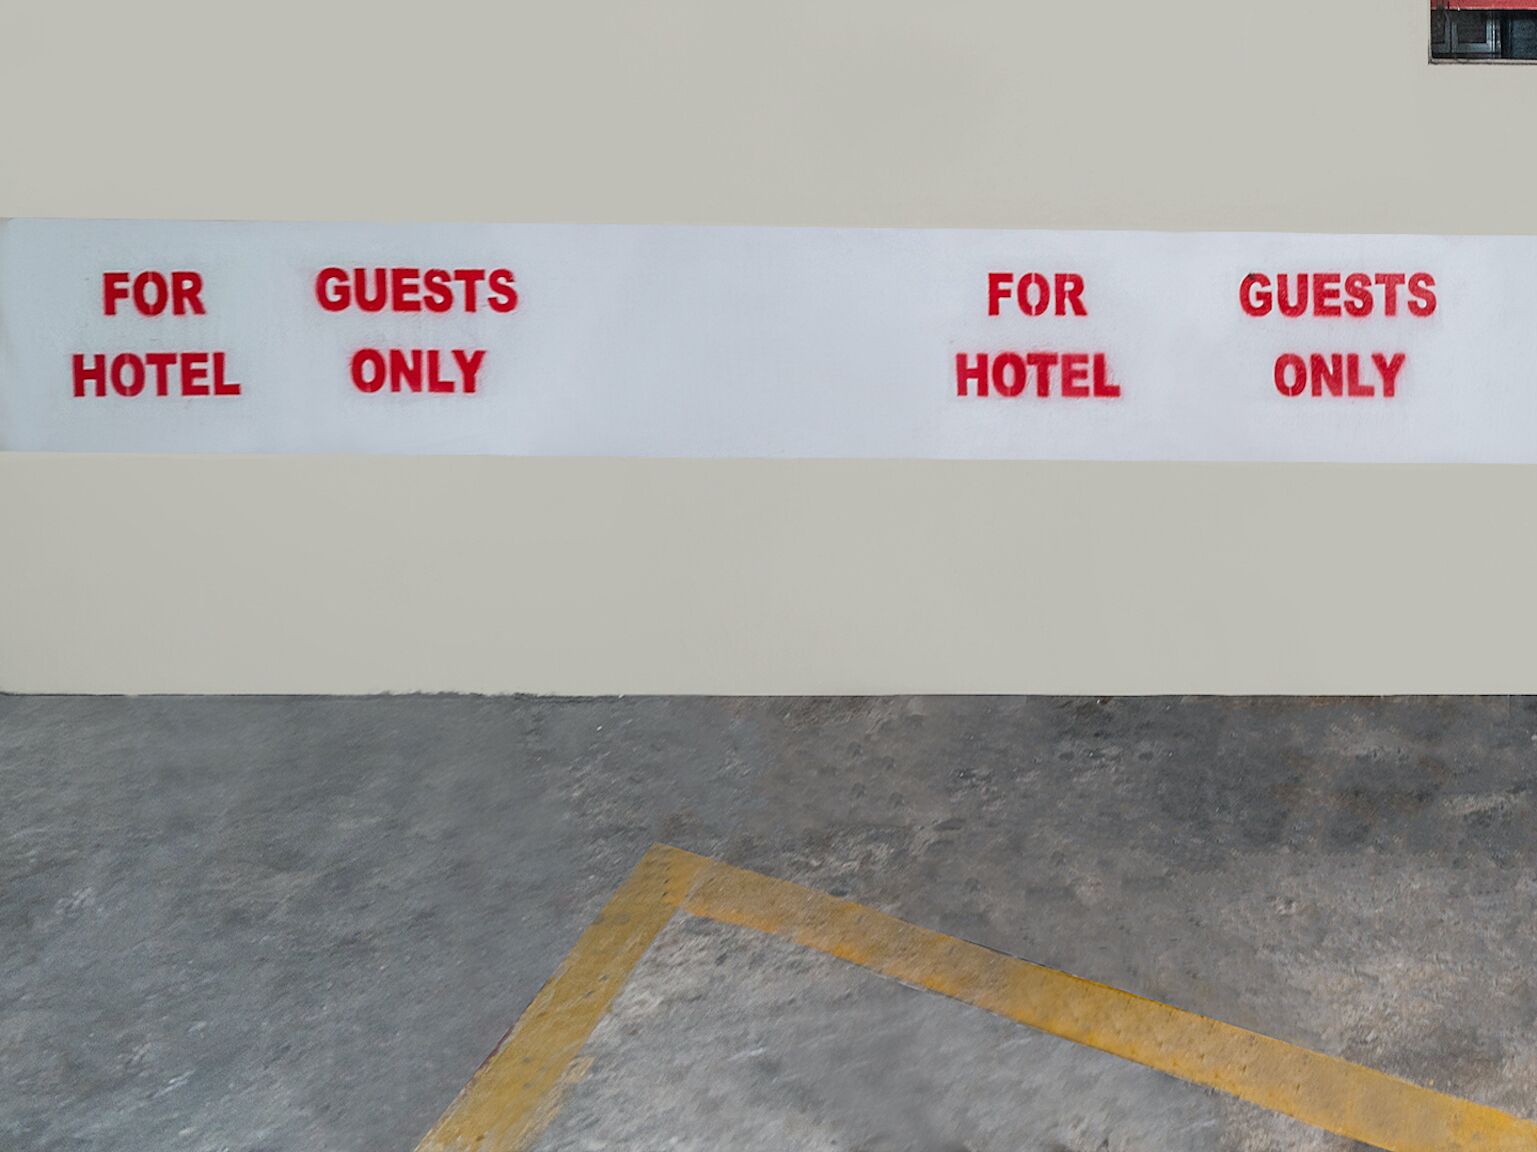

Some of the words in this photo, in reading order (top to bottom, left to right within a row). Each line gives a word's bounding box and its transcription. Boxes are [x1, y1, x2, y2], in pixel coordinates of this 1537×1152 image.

[103, 271, 206, 316] FOR
[315, 266, 519, 313] GUESTS
[987, 272, 1088, 317] FOR
[1239, 272, 1438, 318] GUESTS
[72, 352, 241, 397] HOTEL
[350, 348, 487, 394] ONLY
[955, 352, 1121, 397] HOTEL
[1273, 352, 1407, 398] ONLY
